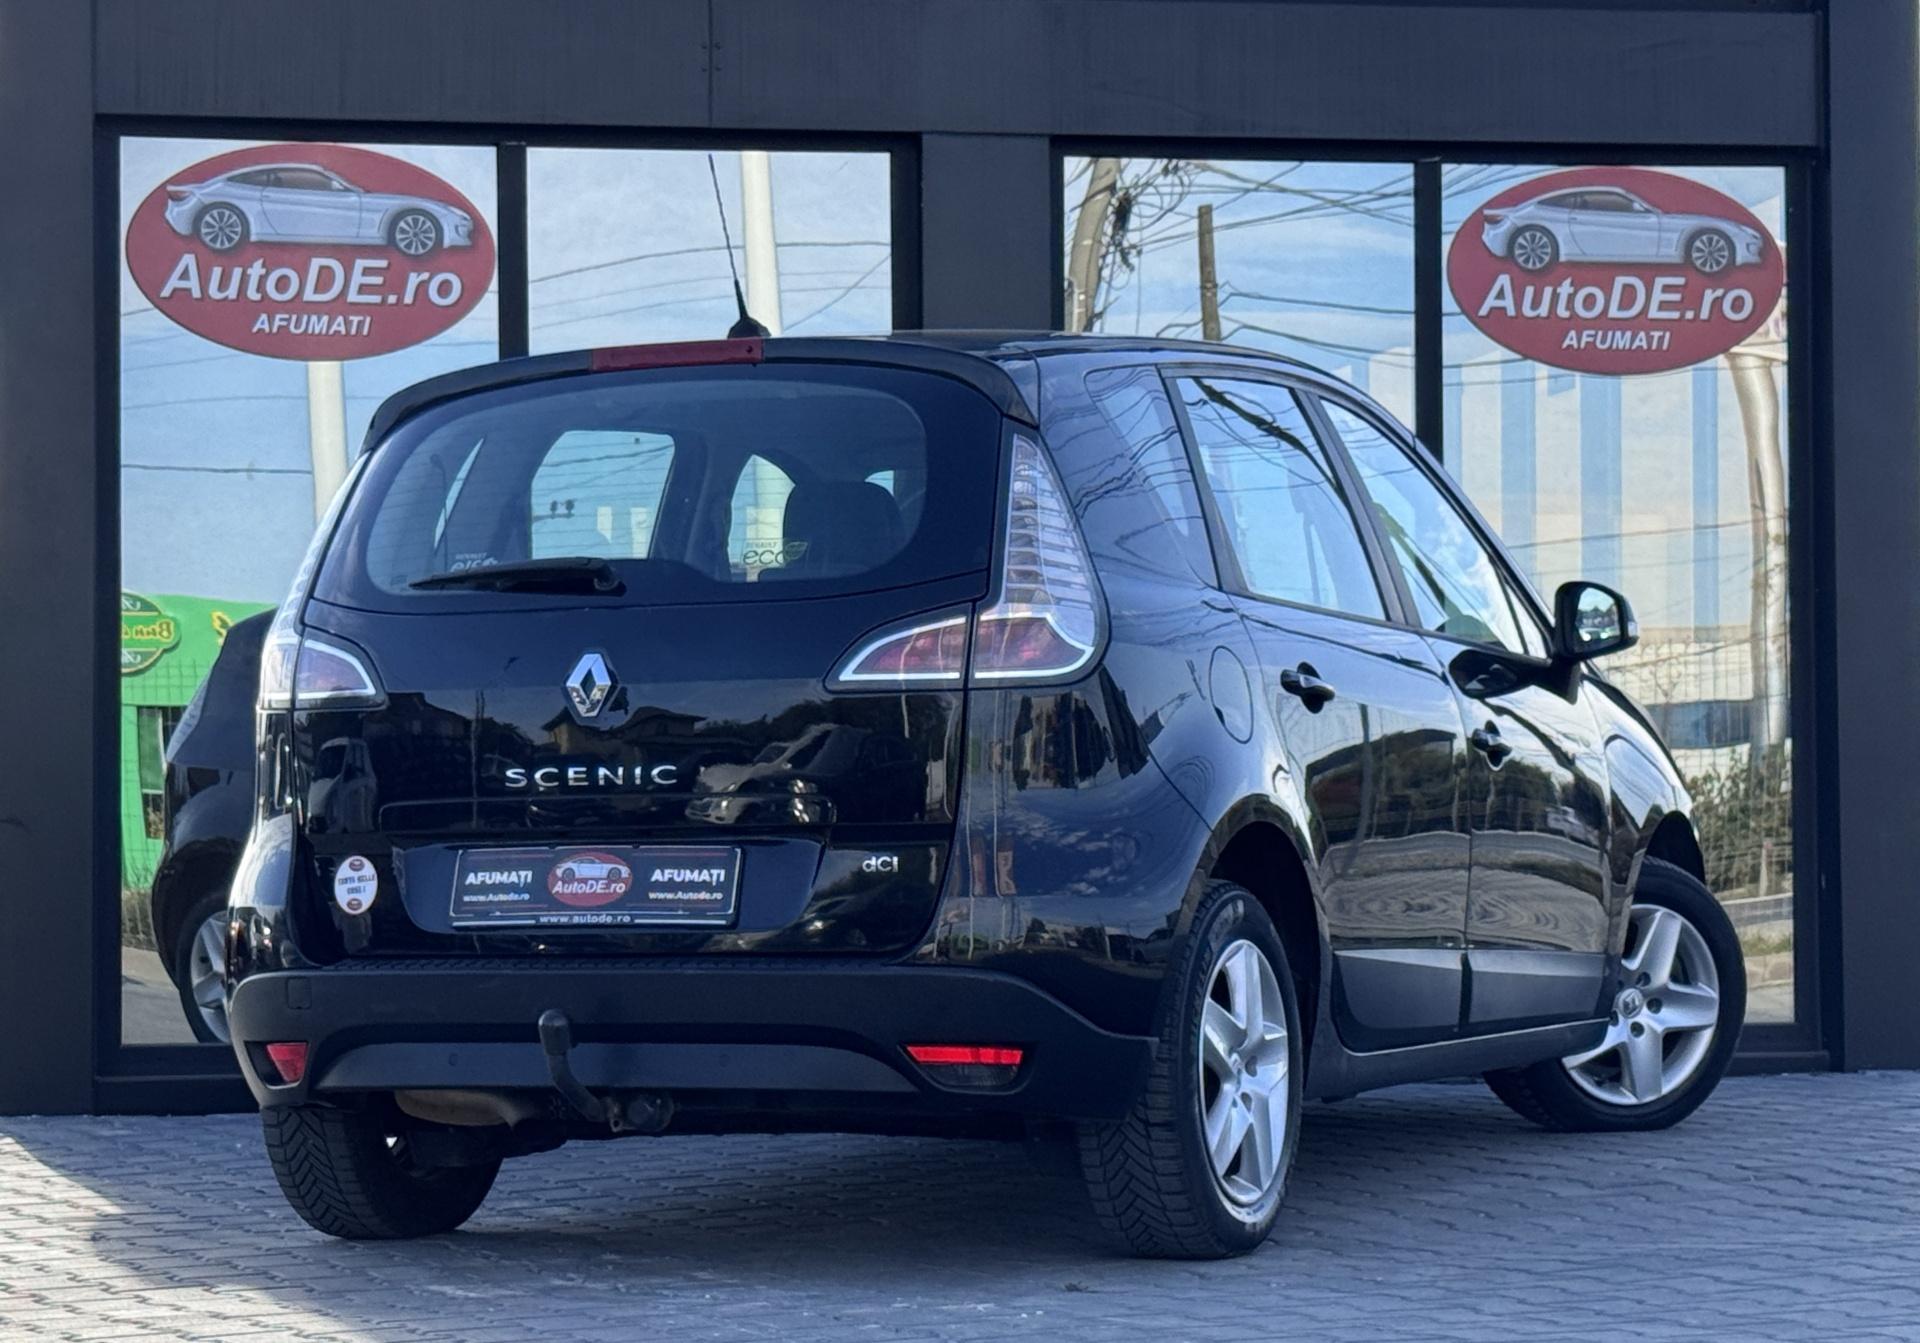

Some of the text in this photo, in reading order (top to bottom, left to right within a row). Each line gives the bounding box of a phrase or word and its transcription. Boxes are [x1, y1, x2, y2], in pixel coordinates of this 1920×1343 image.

[160, 253, 463, 306] AutoDE.ro
[1478, 273, 1754, 321] AutoDE.ro
[252, 313, 372, 336] AFUMATI
[1562, 330, 1671, 350] AFUMATI
[504, 765, 678, 787] SCENIC
[552, 880, 626, 894] AutoDE.ro
[539, 914, 632, 923] www.autode.ro
